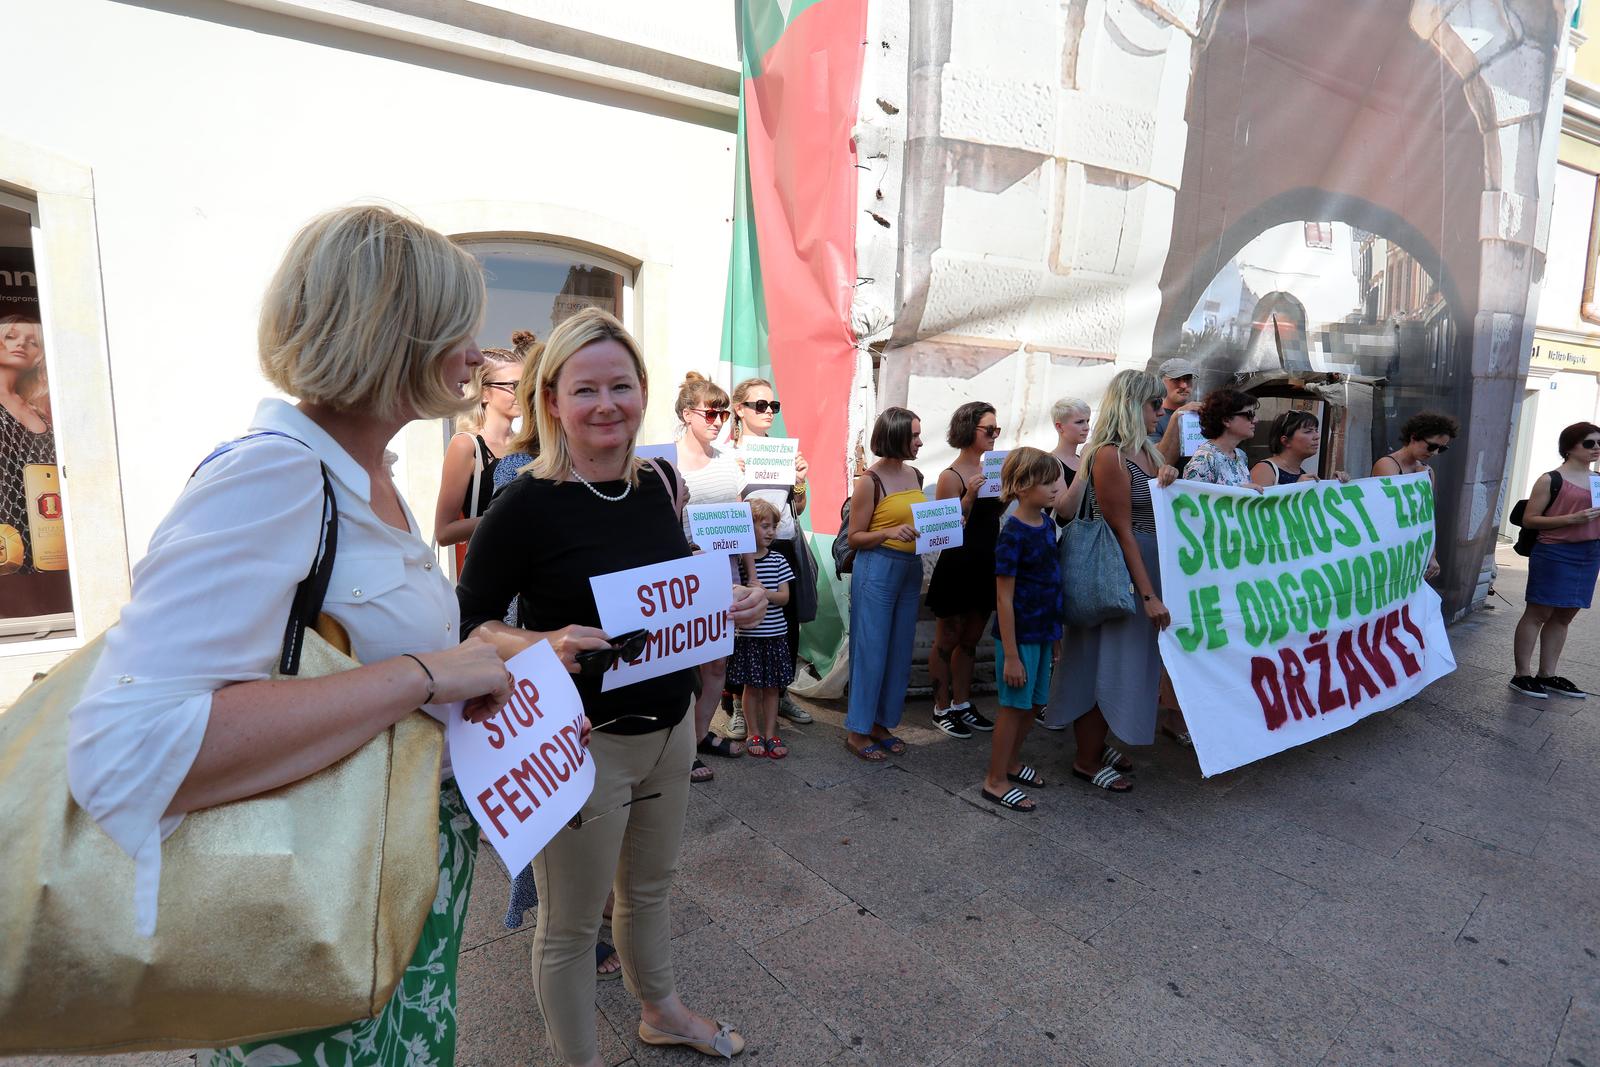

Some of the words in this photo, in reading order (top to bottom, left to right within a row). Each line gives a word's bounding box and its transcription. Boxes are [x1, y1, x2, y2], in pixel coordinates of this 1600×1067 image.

[746, 443, 780, 452] SIGURNOST
[780, 443, 794, 453] ŽENA
[752, 458, 793, 467] ODGOVORNOST
[754, 471, 779, 480] DRŽAVE!
[693, 511, 729, 521] SIGURNOST
[731, 509, 747, 519] ŽENA
[916, 507, 945, 520] SIGURNOST
[945, 505, 958, 516] ŽENA
[696, 527, 705, 536] JE
[706, 525, 751, 536] ODGOVORNOST
[919, 526, 926, 534] JE
[926, 520, 960, 533] ODGOVORNOST
[1171, 484, 1380, 576] SIGURNOST
[713, 539, 739, 550] DRŽAVE!
[929, 536, 950, 547] DRŽAVE!
[637, 574, 700, 617] STOP
[1175, 585, 1228, 652] JE
[1235, 530, 1433, 649] ODGOVORNOST
[611, 609, 728, 672] MICIDU!
[1251, 604, 1426, 731] DRŽAVE!
